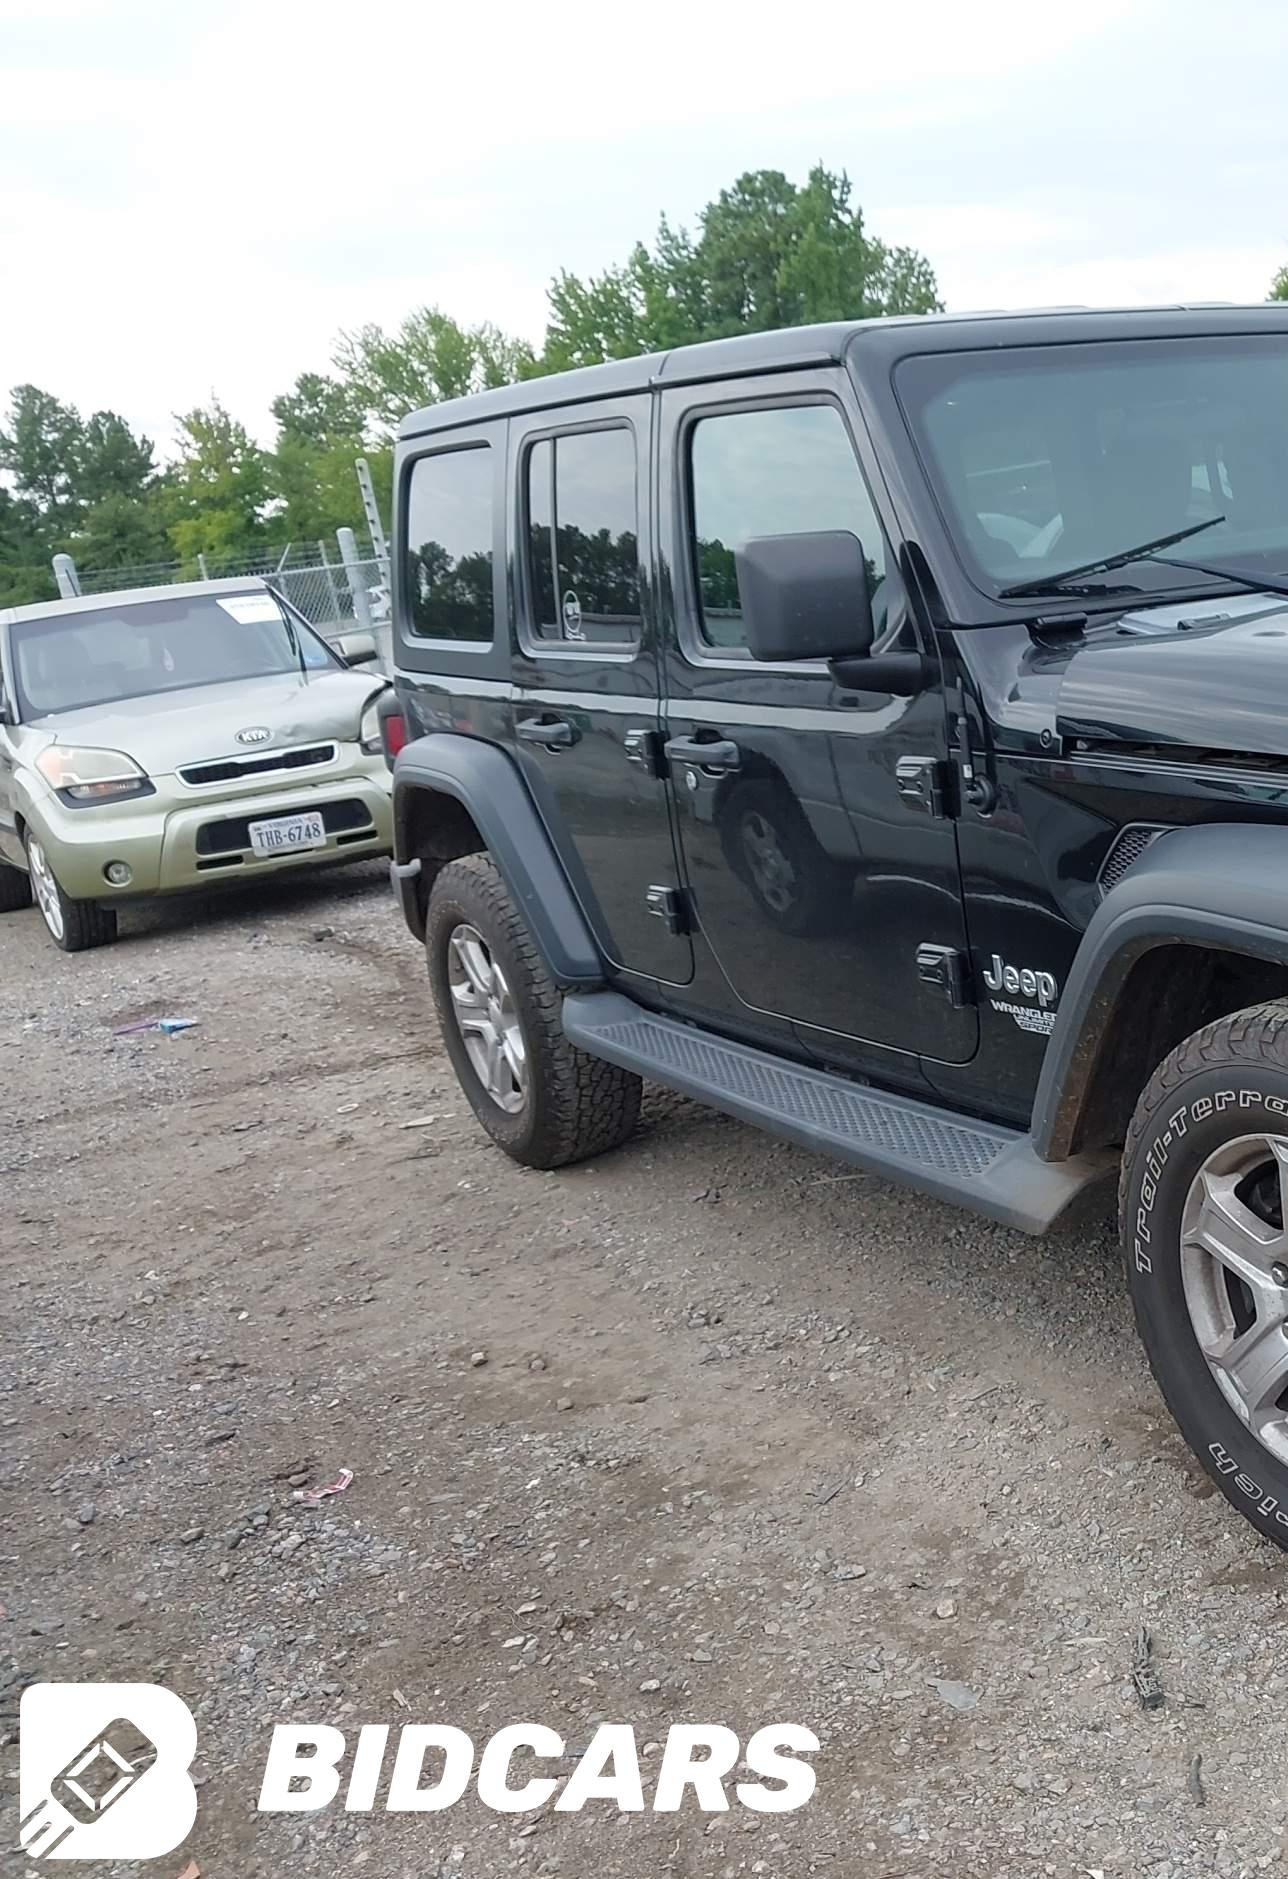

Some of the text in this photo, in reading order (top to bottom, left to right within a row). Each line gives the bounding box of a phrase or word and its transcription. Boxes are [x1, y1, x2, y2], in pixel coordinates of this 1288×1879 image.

[257, 822, 321, 848] THB-6748
[982, 954, 1057, 1007] Jeep
[1013, 1013, 1055, 1027] UNLIMITE
[1020, 1021, 1054, 1034] SPOR
